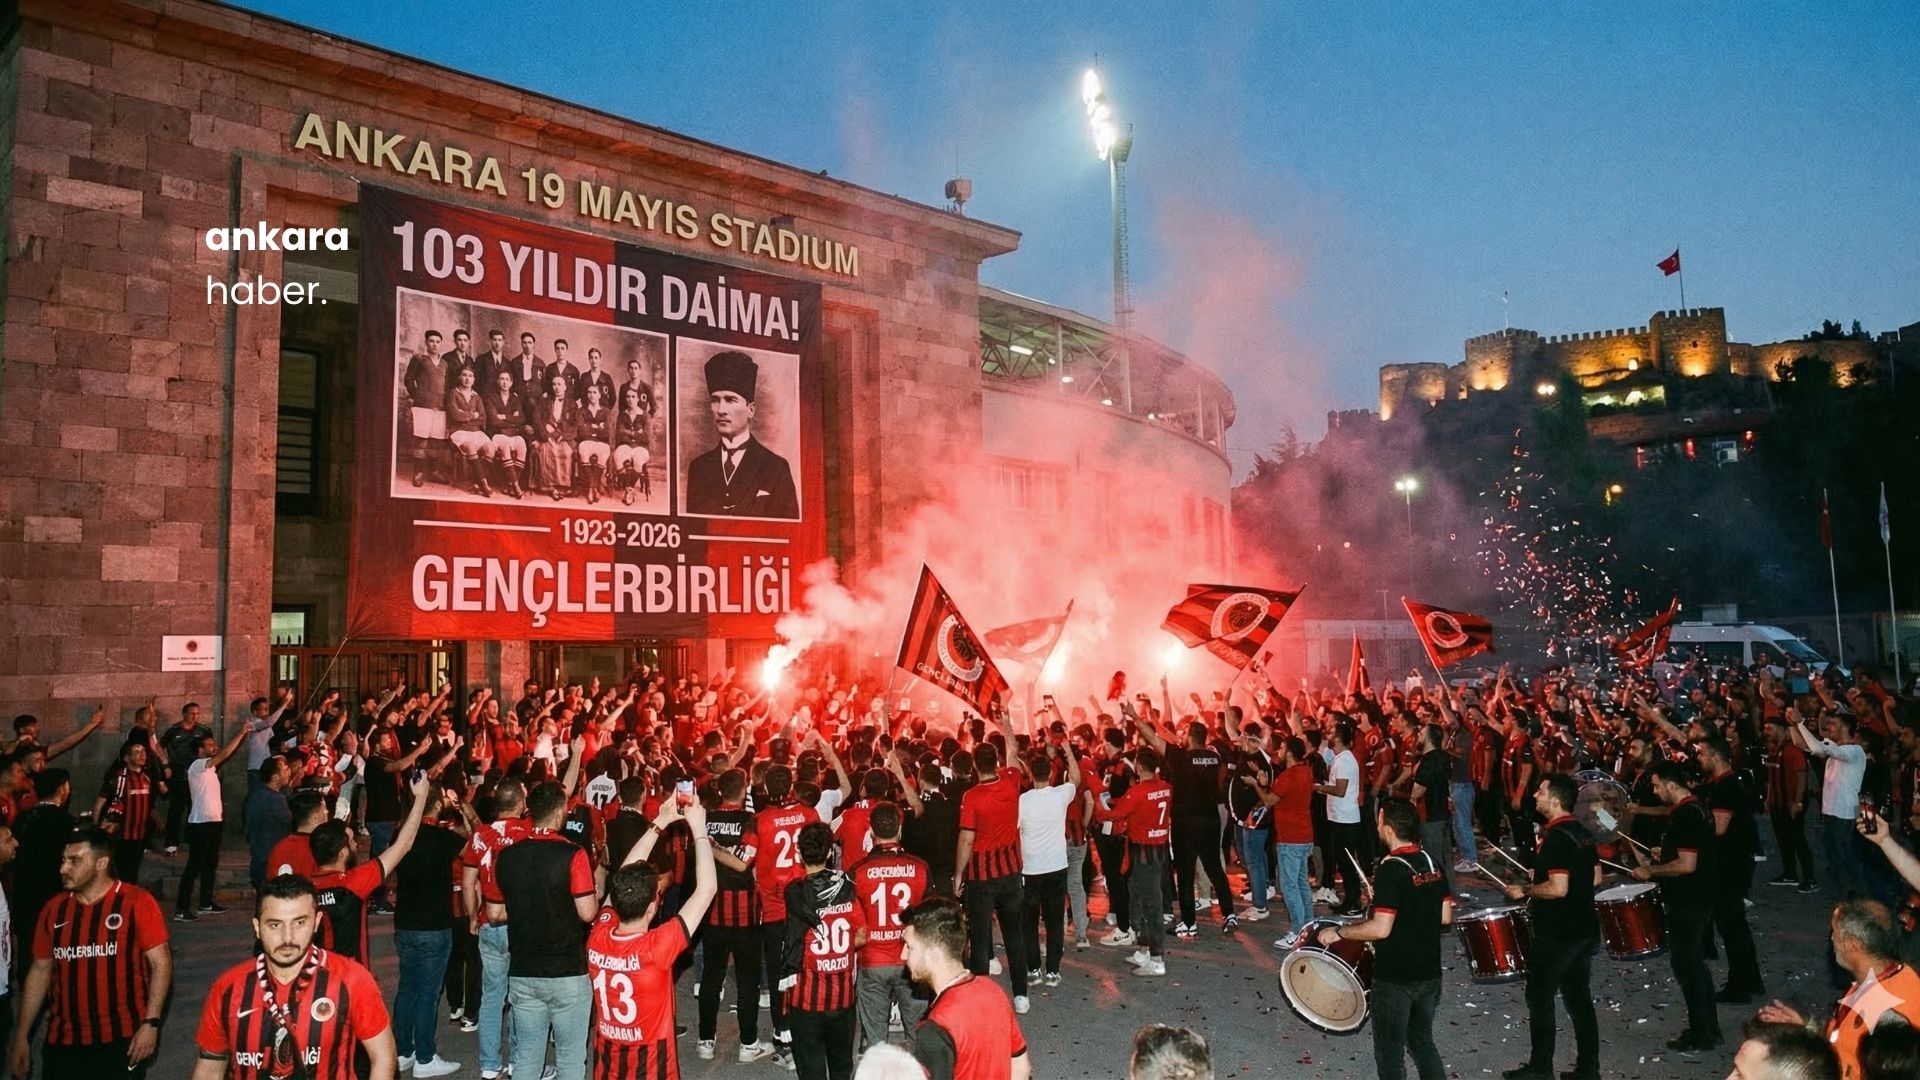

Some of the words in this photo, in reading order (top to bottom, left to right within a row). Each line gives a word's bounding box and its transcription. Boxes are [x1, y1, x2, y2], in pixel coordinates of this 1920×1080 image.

[294, 112, 508, 198] ANKARA
[521, 167, 565, 209] 19
[579, 181, 700, 241] MAYIS
[709, 213, 861, 278] STADIUM
[393, 220, 486, 285] 103
[500, 241, 649, 317] YILDIR
[661, 275, 802, 342] DAİMA!
[559, 517, 682, 549] 1923-2026
[411, 553, 792, 628] GENÇLERBİRLİĞİ
[1158, 801, 1167, 825] 7
[870, 882, 911, 926] 13
[593, 969, 638, 1025] 13
